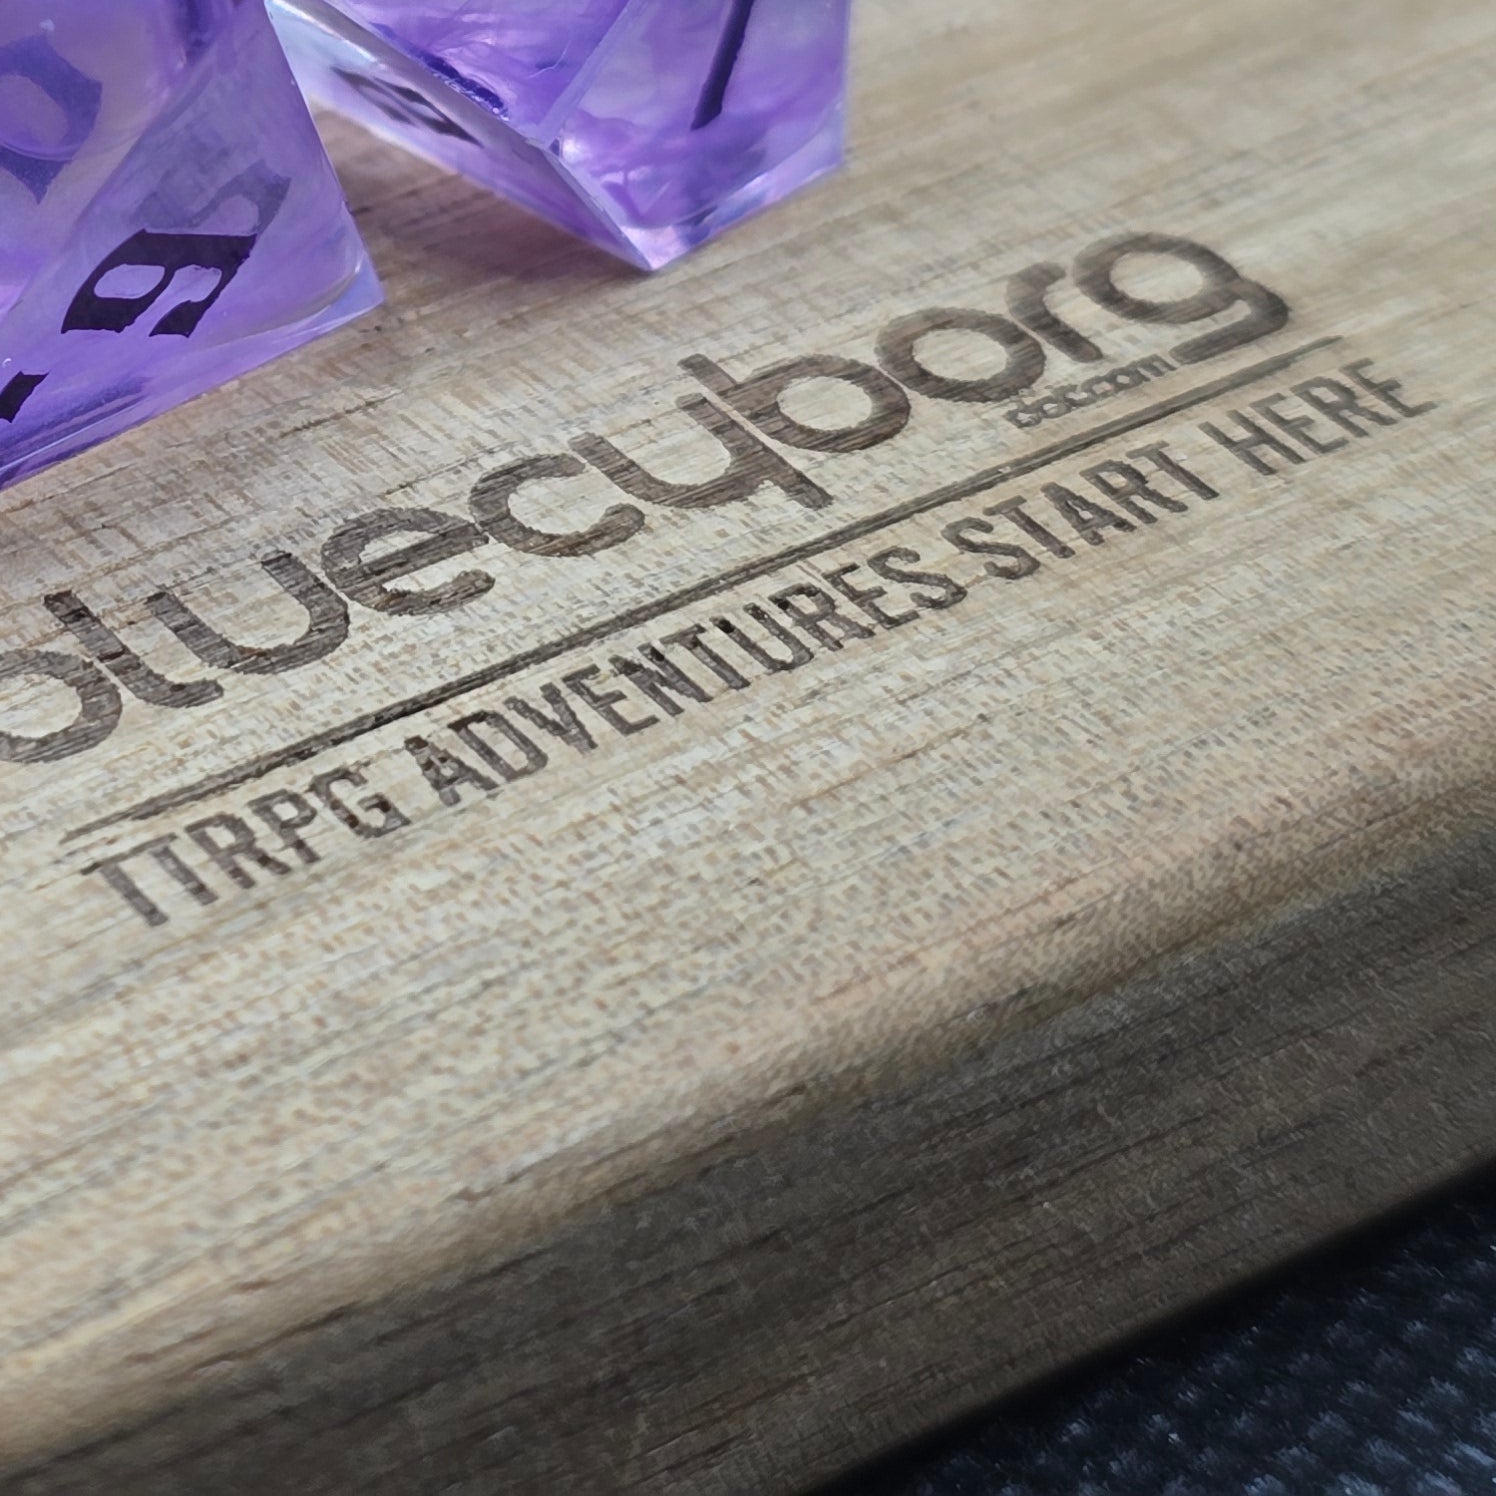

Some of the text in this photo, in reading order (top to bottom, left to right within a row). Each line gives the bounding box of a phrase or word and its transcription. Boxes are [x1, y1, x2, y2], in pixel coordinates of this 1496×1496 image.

[80, 357, 1439, 927] TTRPG ADVENTURES START HERE
